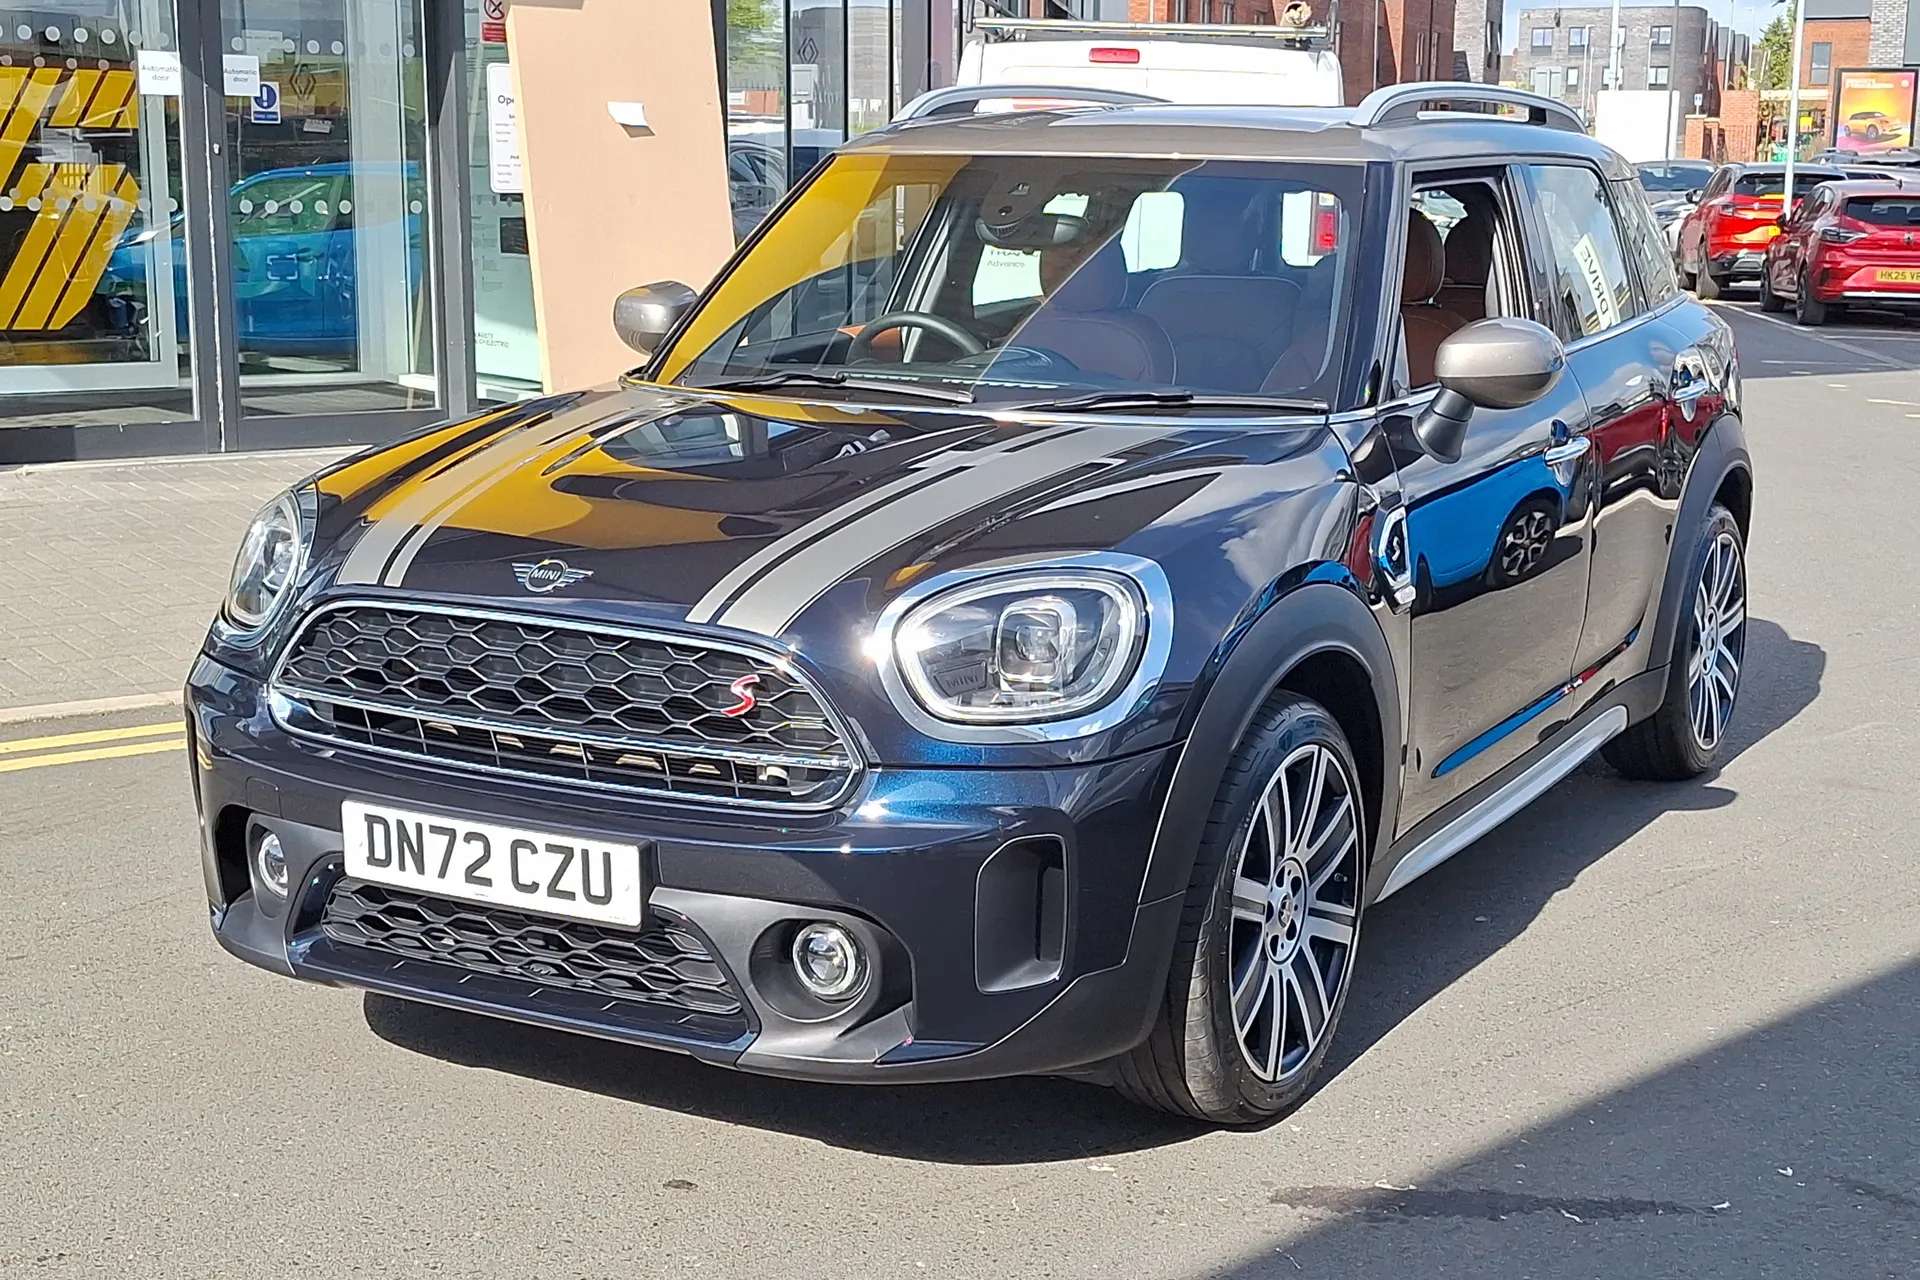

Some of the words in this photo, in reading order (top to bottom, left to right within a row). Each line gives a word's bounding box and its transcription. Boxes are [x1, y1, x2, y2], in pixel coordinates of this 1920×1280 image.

[141, 64, 179, 72] Automatic
[1880, 271, 1907, 280] HK25
[531, 568, 561, 580] MINI
[720, 674, 760, 717] S
[364, 814, 493, 888] DN72
[510, 838, 613, 906] CZU
